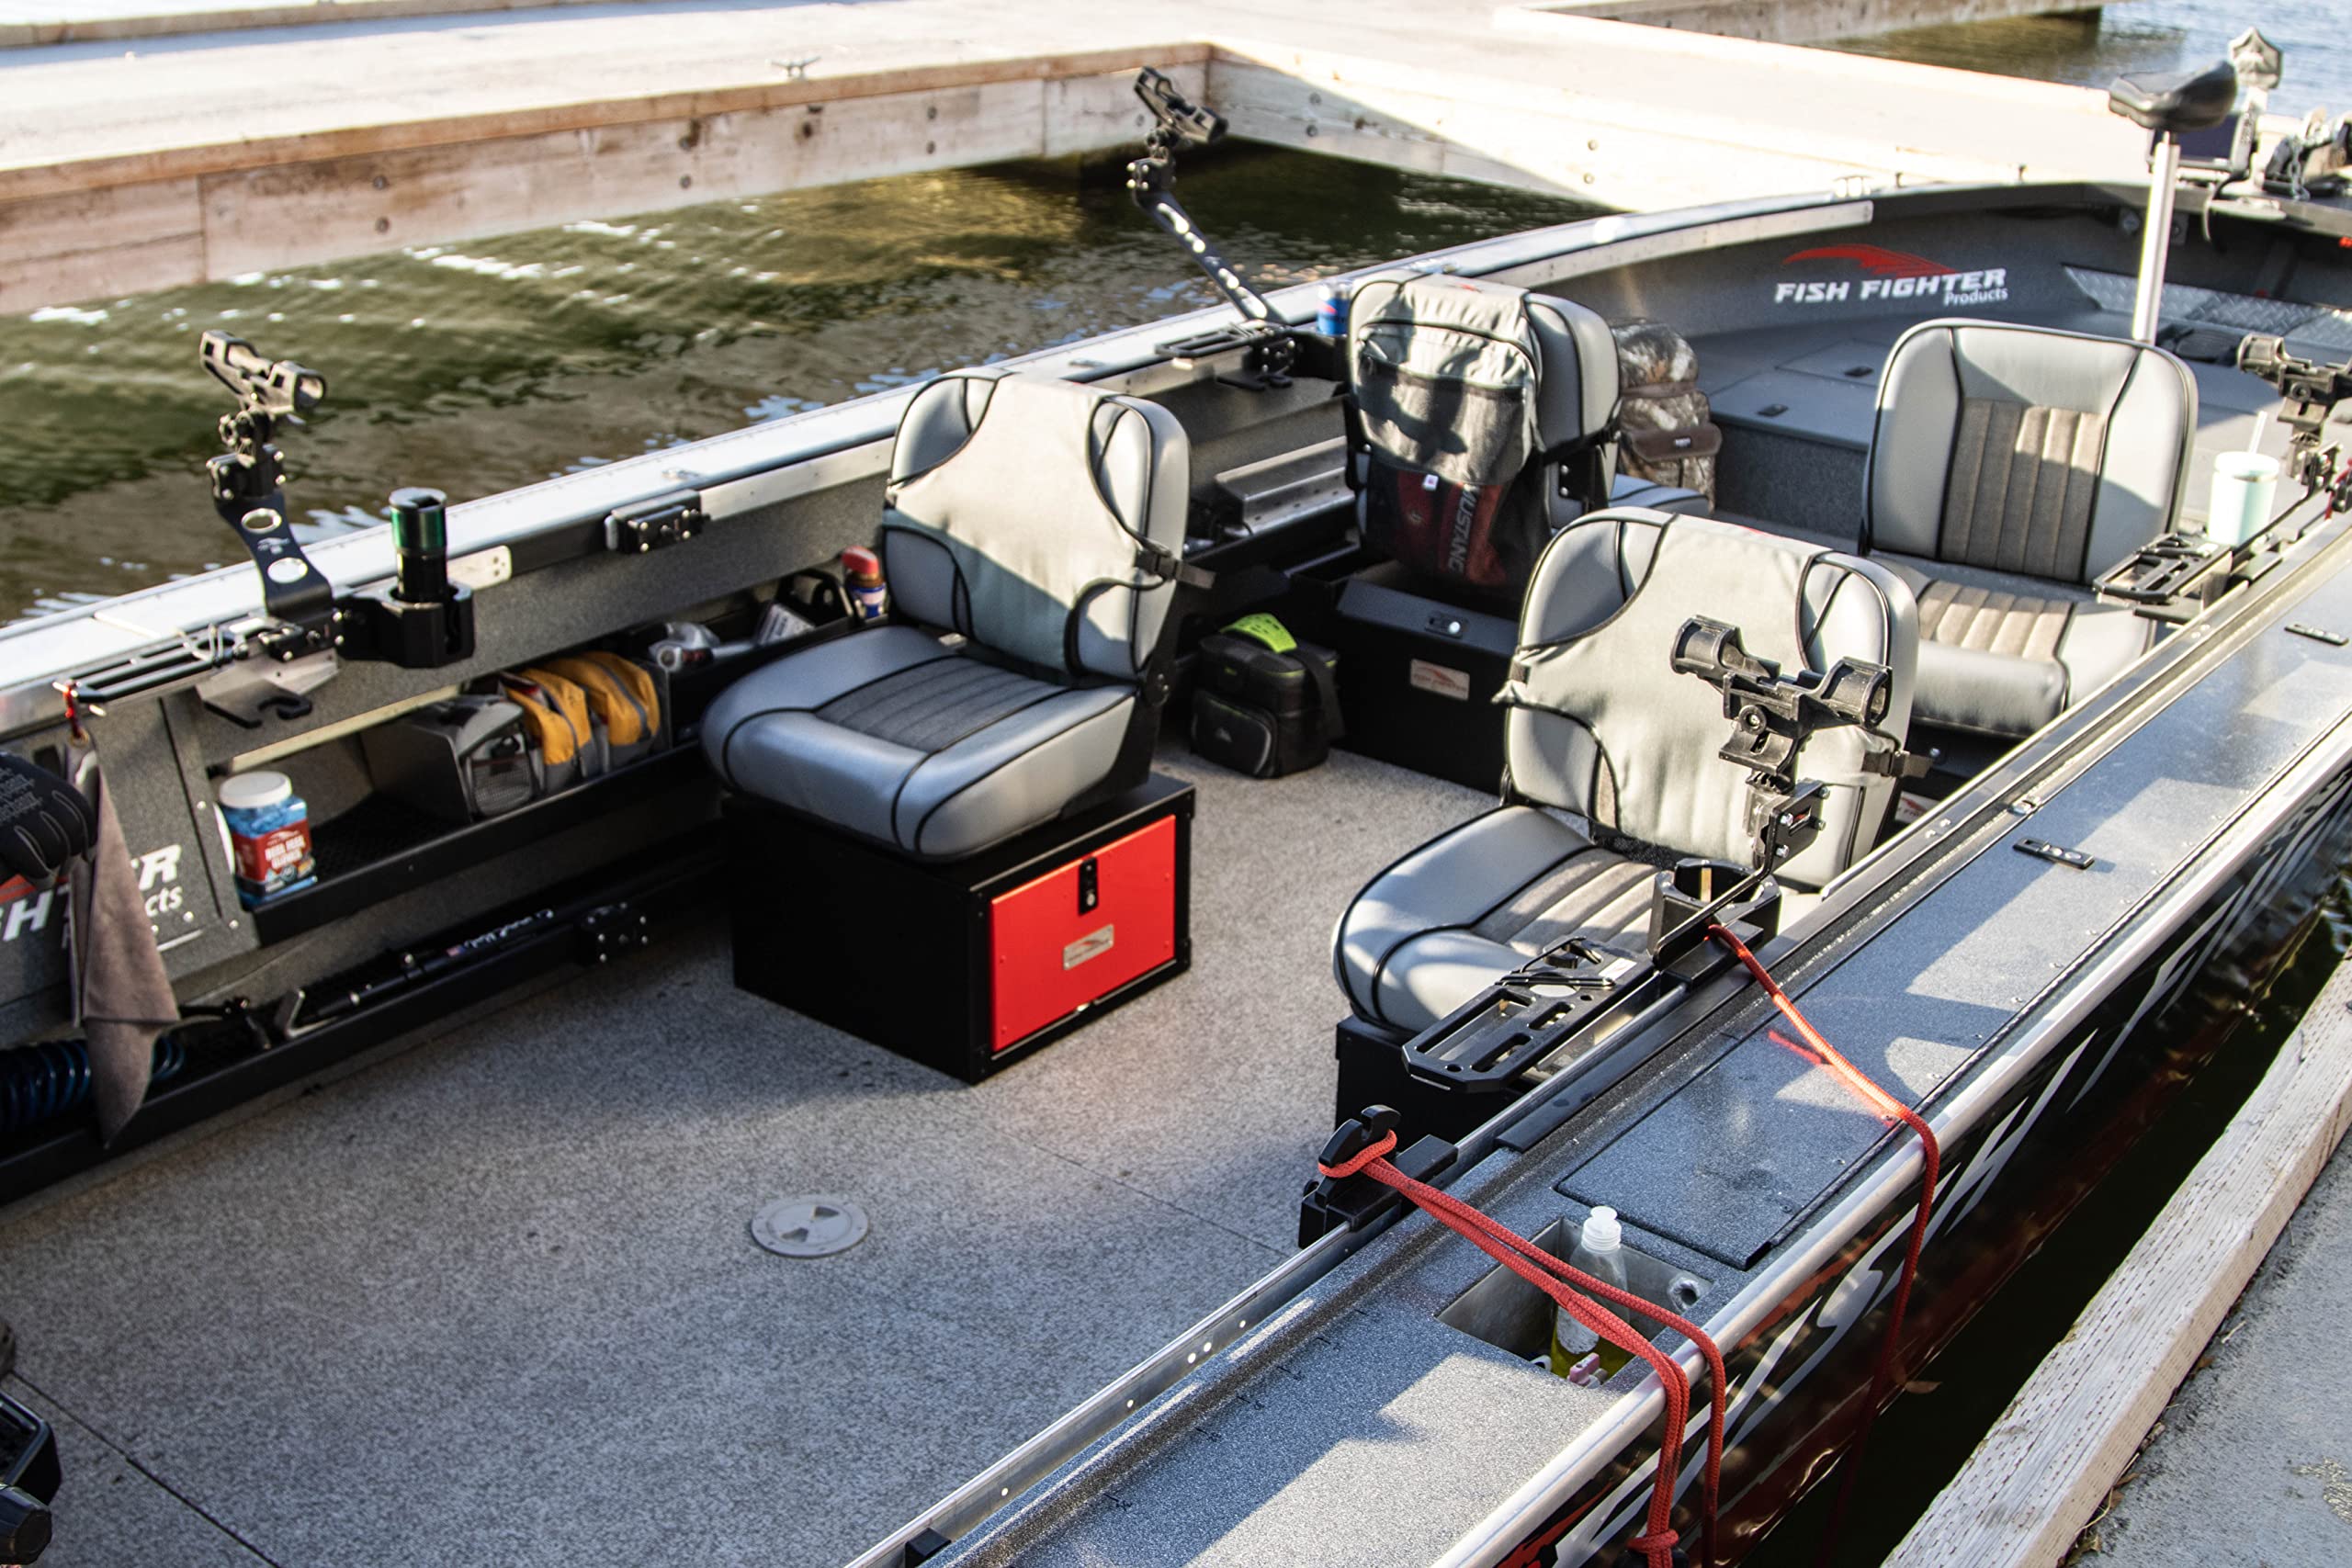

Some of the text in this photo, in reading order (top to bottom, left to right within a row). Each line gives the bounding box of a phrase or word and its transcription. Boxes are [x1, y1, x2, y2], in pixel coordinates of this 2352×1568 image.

[1775, 268, 2007, 303] FISH FIGHTER
[1943, 287, 2008, 306] Products
